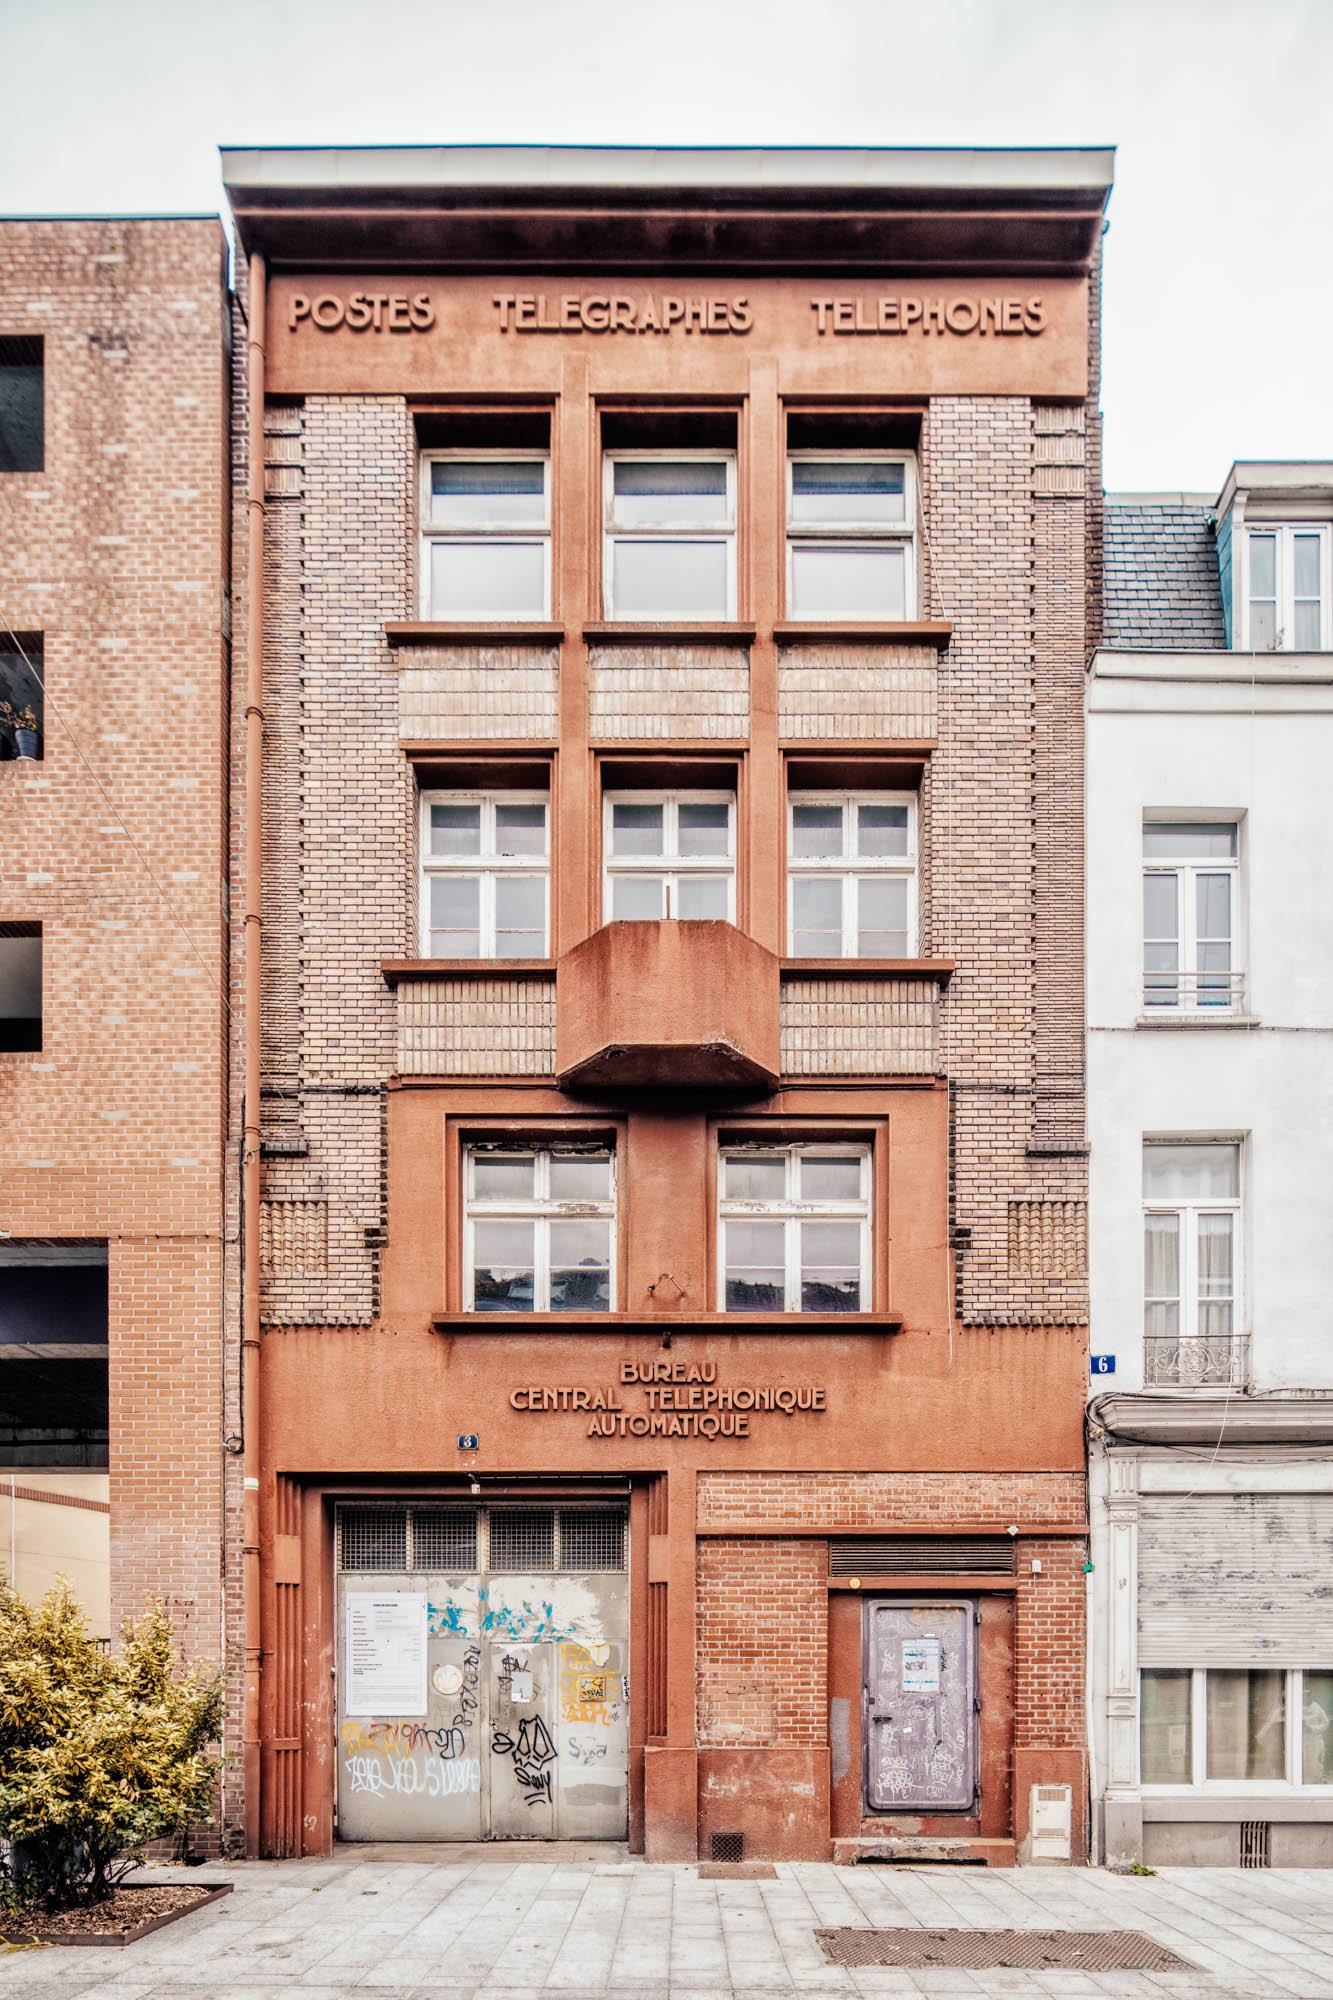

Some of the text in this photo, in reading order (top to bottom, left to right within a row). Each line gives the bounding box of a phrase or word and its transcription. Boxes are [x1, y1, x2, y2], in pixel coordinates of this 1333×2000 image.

[288, 293, 1048, 336] POSTES TELEGRAPHES TELEPHONES
[619, 1360, 717, 1384] BUREAU
[1098, 1356, 1108, 1373] 6
[509, 1386, 827, 1414] CENTRAL TELEPHONIQUE
[586, 1413, 751, 1440] AUTOMATIQUE
[463, 1435, 472, 1448] 3
